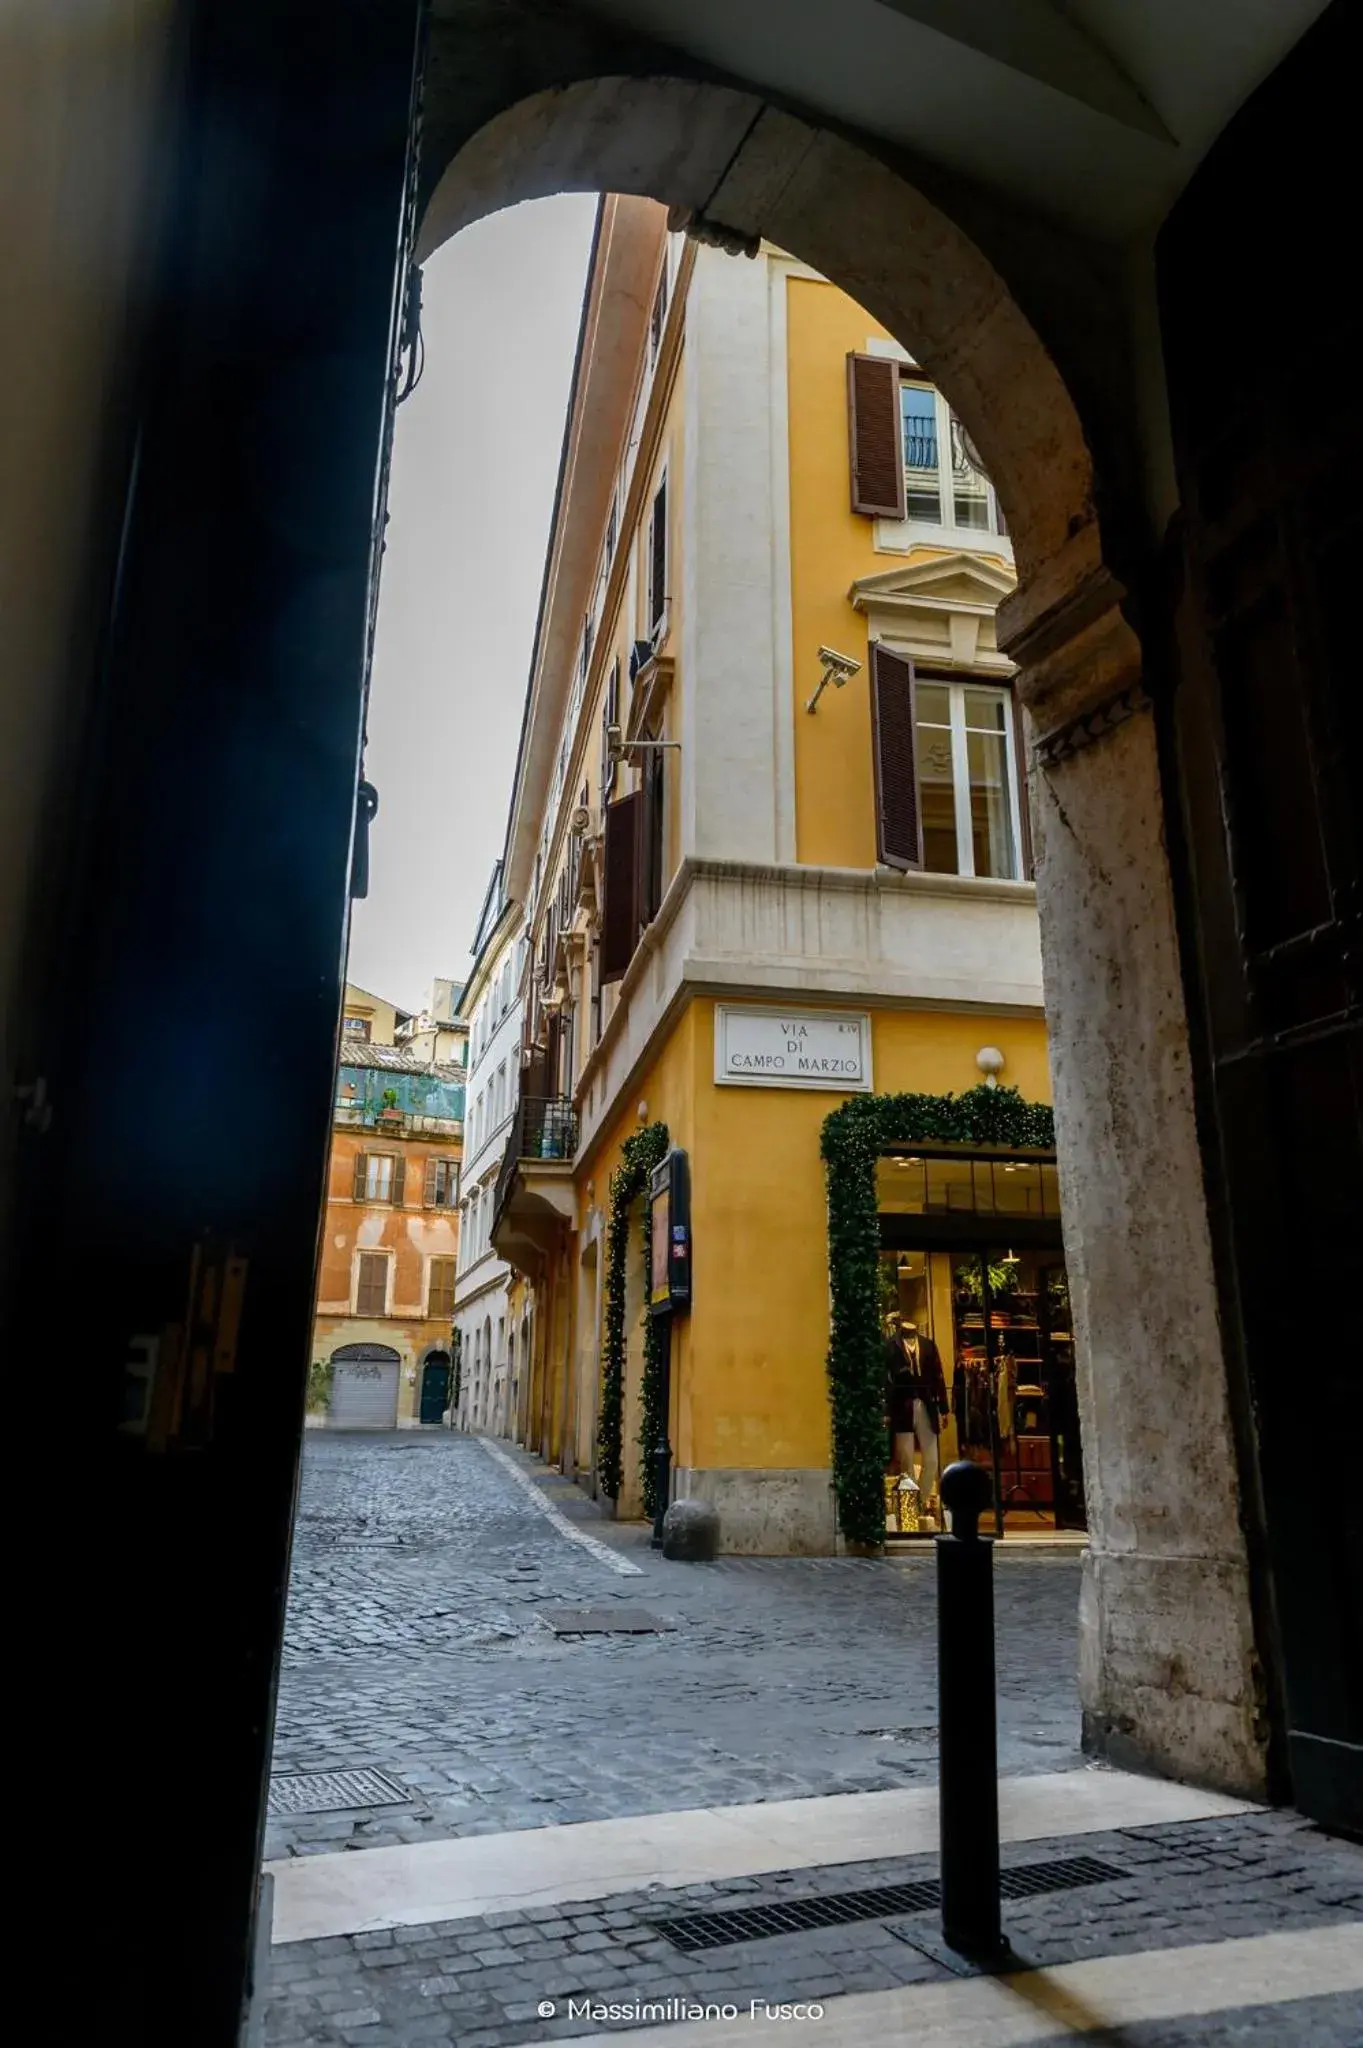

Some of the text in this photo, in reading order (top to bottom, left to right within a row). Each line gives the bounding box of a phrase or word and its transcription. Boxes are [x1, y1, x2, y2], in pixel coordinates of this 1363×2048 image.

[780, 1023, 808, 1037] VIA
[787, 1040, 803, 1053] DI
[731, 1053, 857, 1073] CAMPO MARZIO
